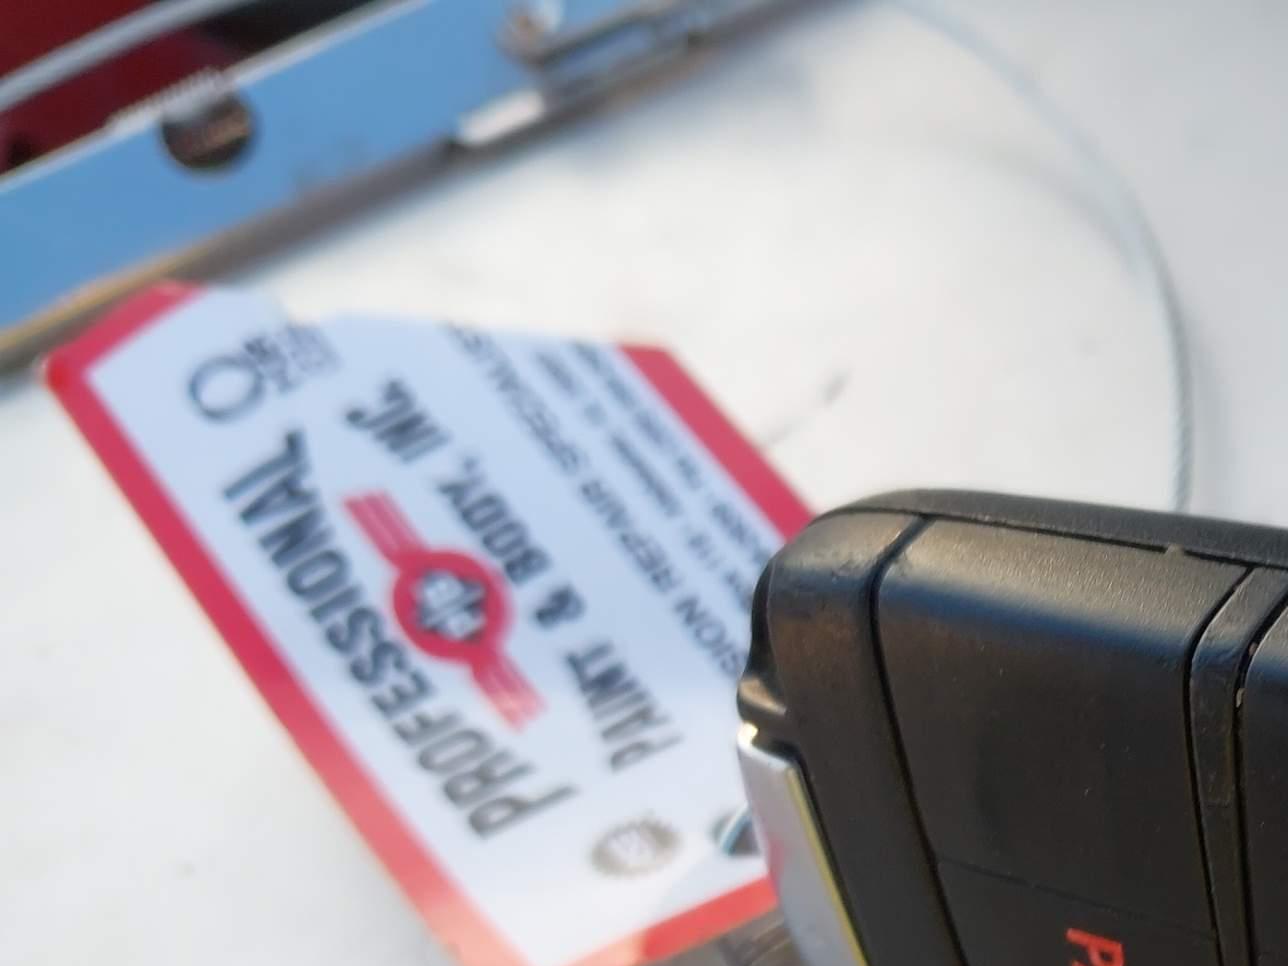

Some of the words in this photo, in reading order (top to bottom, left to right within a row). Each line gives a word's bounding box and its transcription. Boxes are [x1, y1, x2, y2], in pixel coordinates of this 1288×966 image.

[345, 379, 449, 464] INC.
[435, 452, 550, 586] BODY,
[220, 430, 578, 839] PROFESSIONAL
[534, 588, 587, 630] &
[567, 640, 682, 774] PAINT
